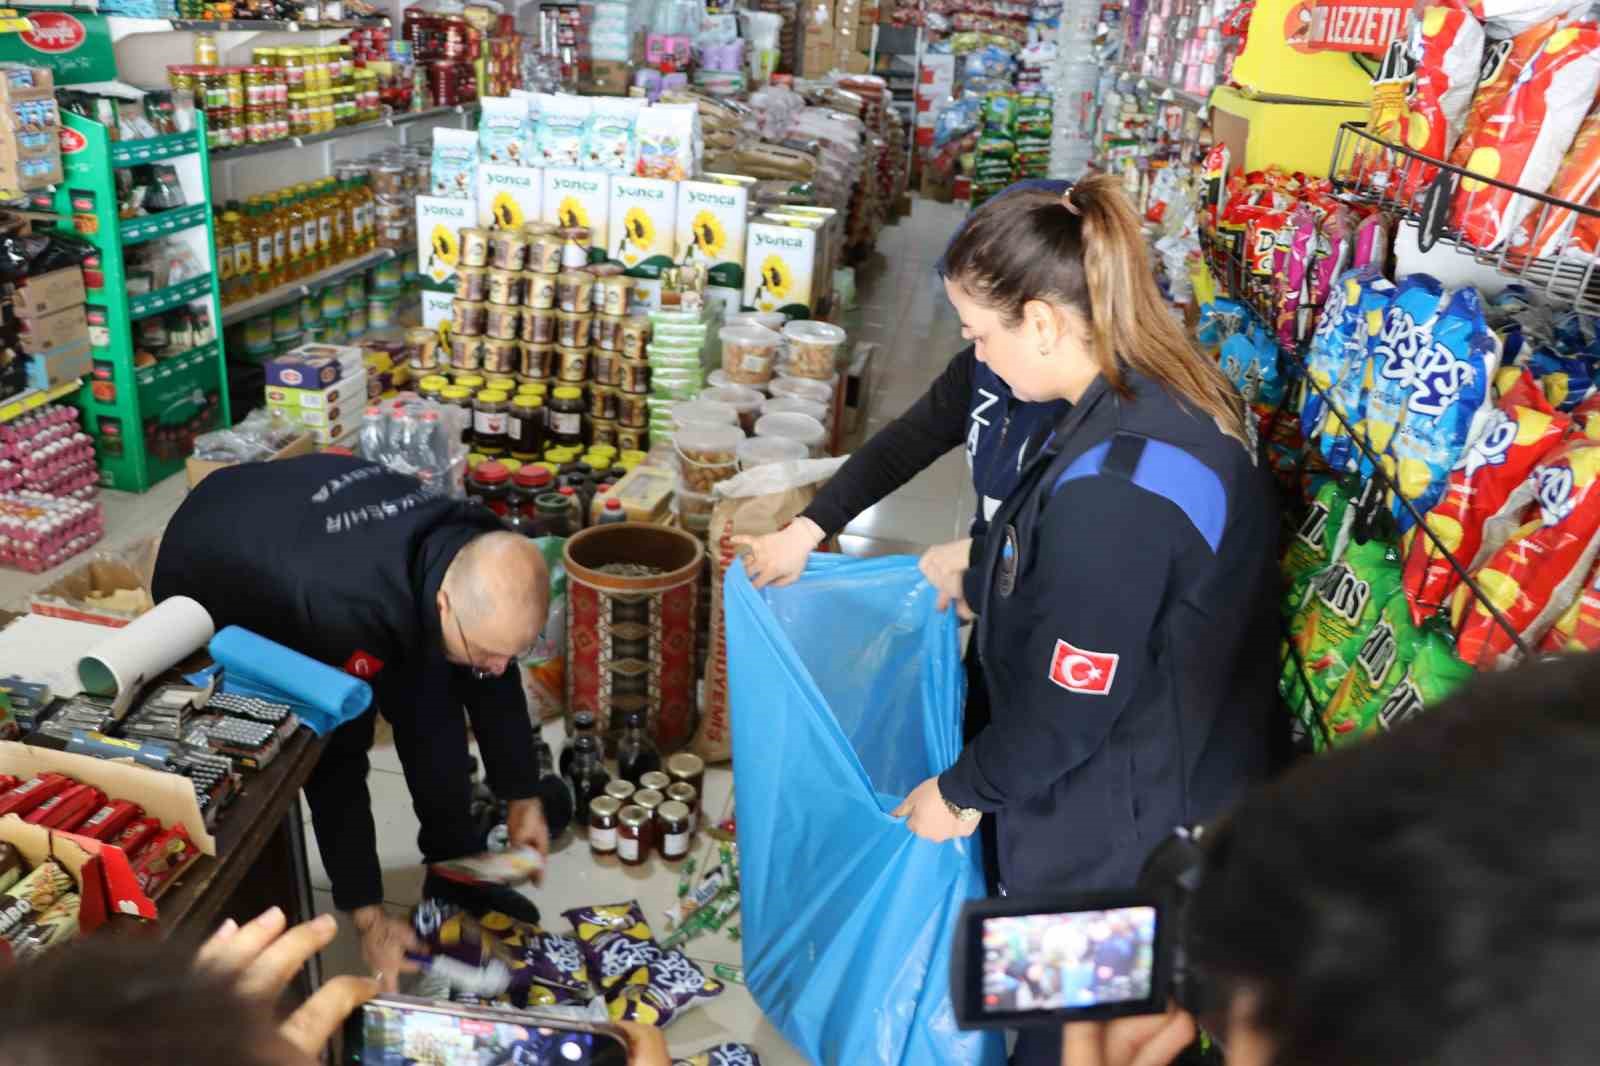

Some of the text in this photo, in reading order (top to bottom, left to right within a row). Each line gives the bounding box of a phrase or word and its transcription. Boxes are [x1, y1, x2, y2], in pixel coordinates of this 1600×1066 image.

[486, 171, 531, 188] yonca
[552, 176, 598, 193] yonca
[616, 184, 664, 201] yonca
[687, 190, 736, 207] yonca
[423, 204, 465, 217] yonca
[755, 231, 803, 249] yonca
